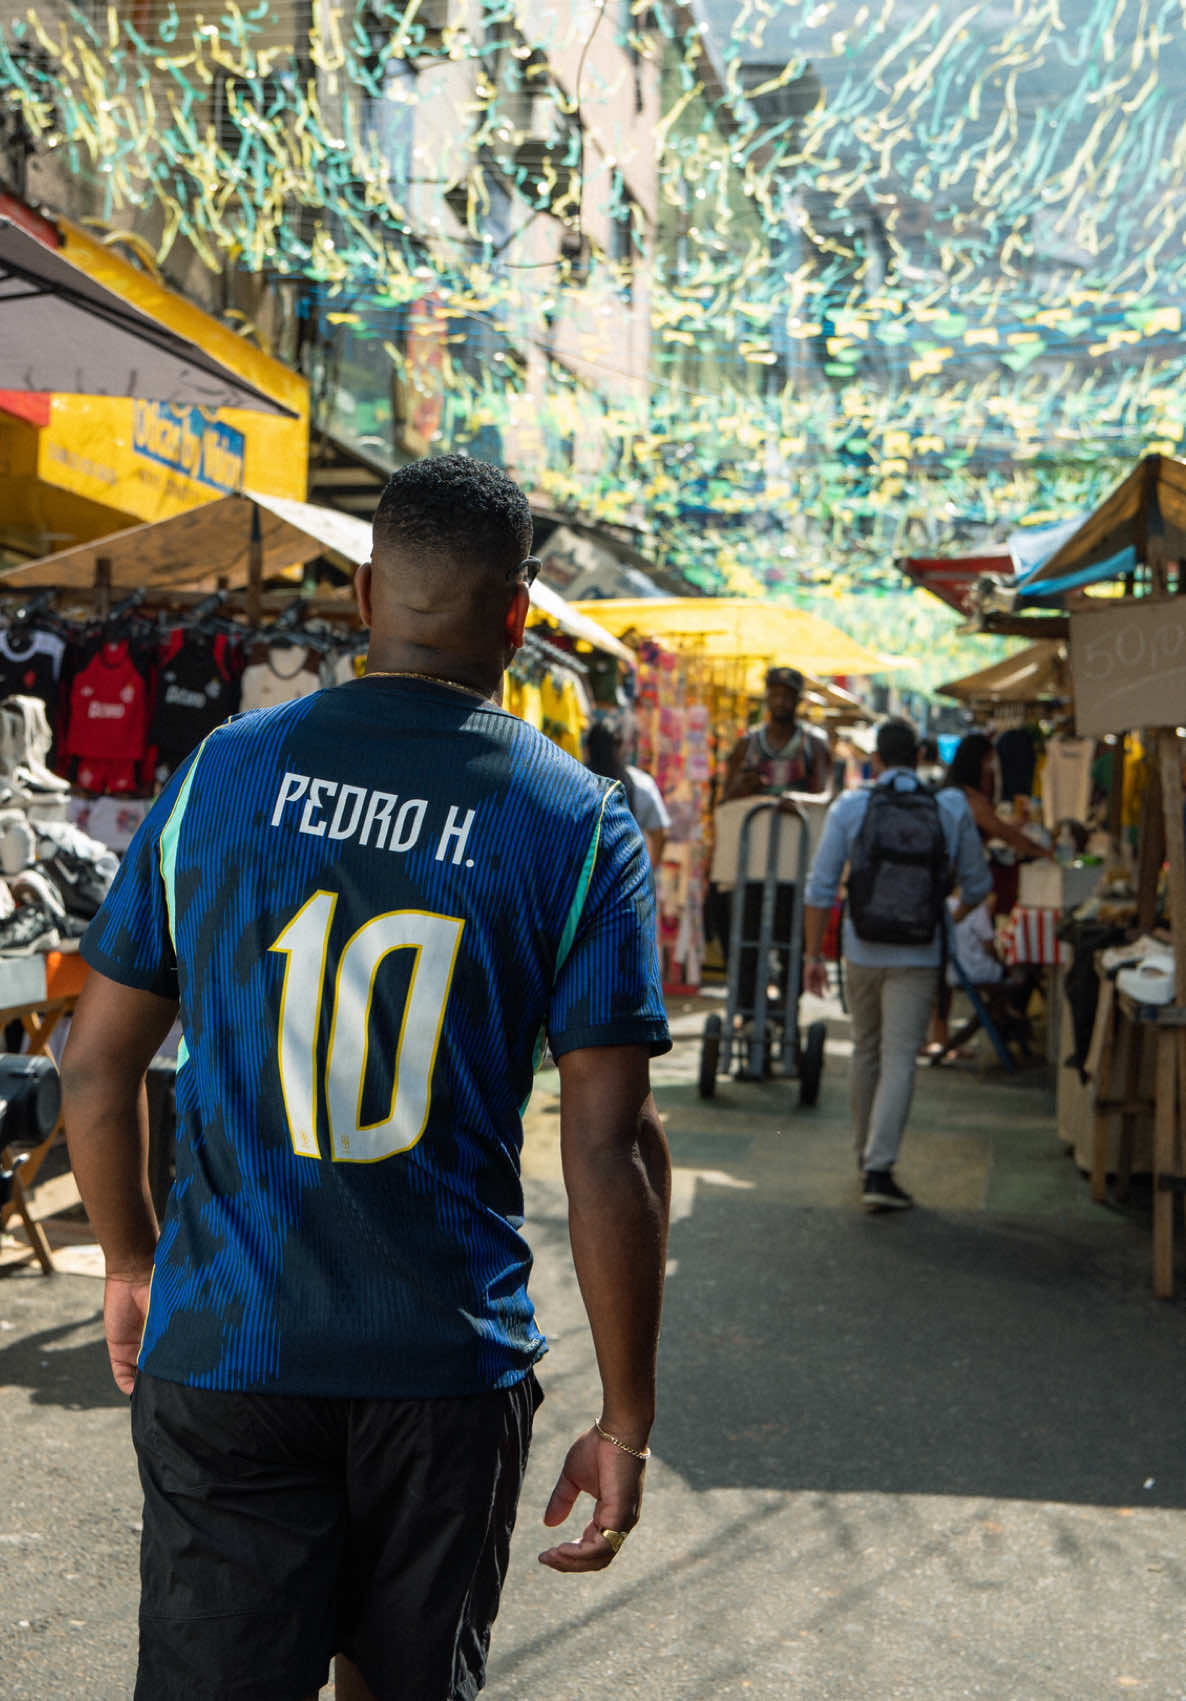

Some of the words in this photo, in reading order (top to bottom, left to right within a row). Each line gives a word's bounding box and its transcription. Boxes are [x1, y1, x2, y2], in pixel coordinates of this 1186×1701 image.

[270, 772, 428, 852] PEDRO
[434, 805, 476, 868] H.
[267, 889, 465, 1164] 10
